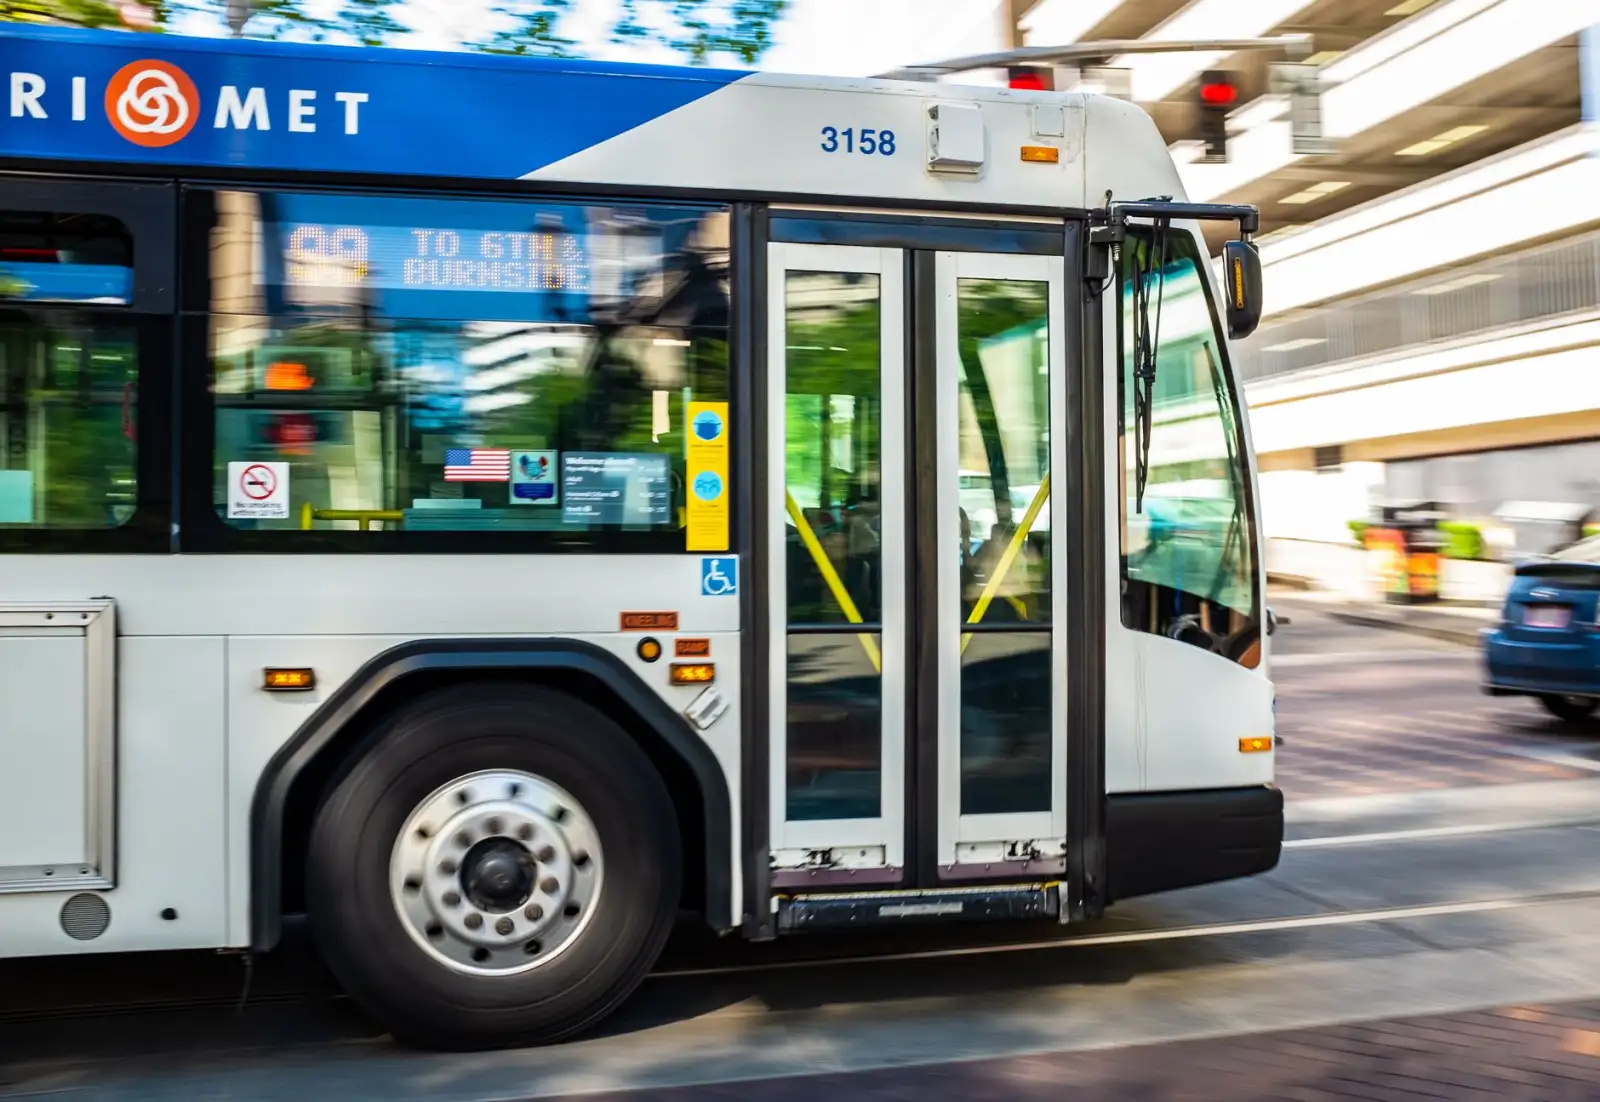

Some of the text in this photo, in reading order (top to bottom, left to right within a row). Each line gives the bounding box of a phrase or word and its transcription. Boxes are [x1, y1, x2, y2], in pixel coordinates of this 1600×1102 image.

[213, 85, 369, 135] MET
[820, 125, 896, 156] 3158
[411, 228, 583, 262] TO 6TH &
[403, 258, 591, 290] BURNSIDE
